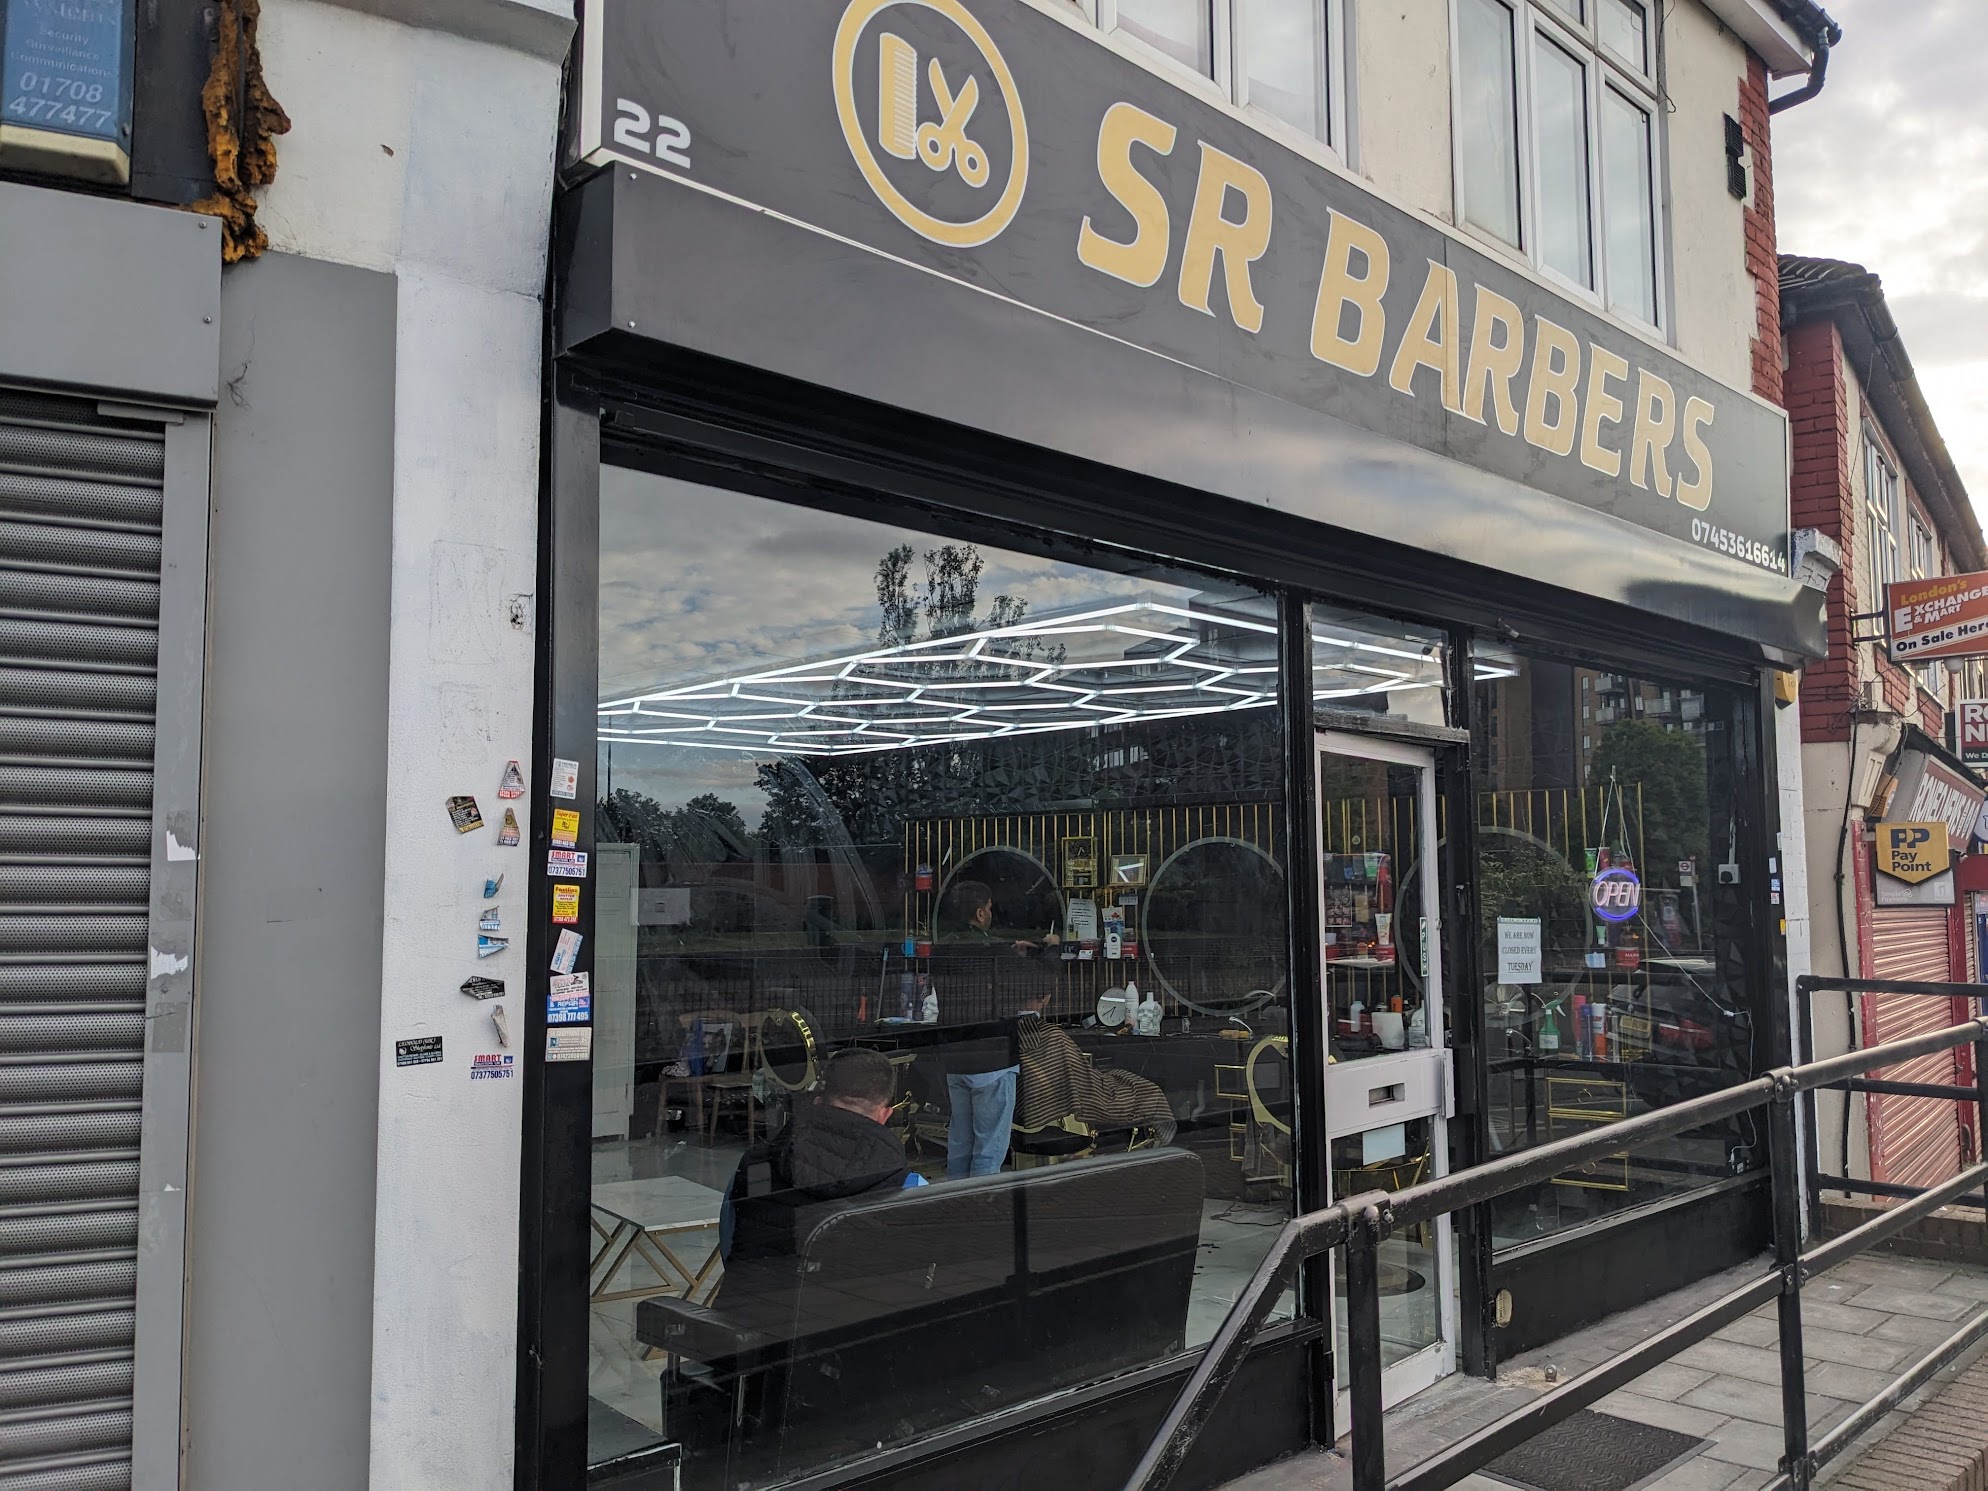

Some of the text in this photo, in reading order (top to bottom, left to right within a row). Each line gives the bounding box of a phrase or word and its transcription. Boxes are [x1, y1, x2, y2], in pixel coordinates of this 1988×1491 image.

[20, 72, 103, 103] 01708
[9, 95, 112, 128] 477477
[614, 98, 691, 169] 22
[1077, 102, 1715, 511] SR BARBERS
[1692, 518, 1785, 572] 07453616614
[1900, 580, 1967, 606] London's
[1914, 604, 1962, 624] & MART
[1896, 641, 1917, 652] On
[1921, 631, 1954, 646] Sale
[551, 850, 576, 859] SMART
[1892, 851, 1918, 862] Pay
[548, 865, 586, 877] 07377505751
[1892, 861, 1931, 872] Point
[1594, 881, 1640, 907] OPEN
[1504, 931, 1535, 939] WE ARE NOW
[1502, 946, 1537, 954] CLOSED EVERY
[1507, 961, 1533, 971] TUESDAY
[548, 1013, 566, 1022] 07398
[577, 1011, 589, 1021] 495
[474, 1054, 501, 1062] SMART
[471, 1069, 514, 1080] 07377505751
